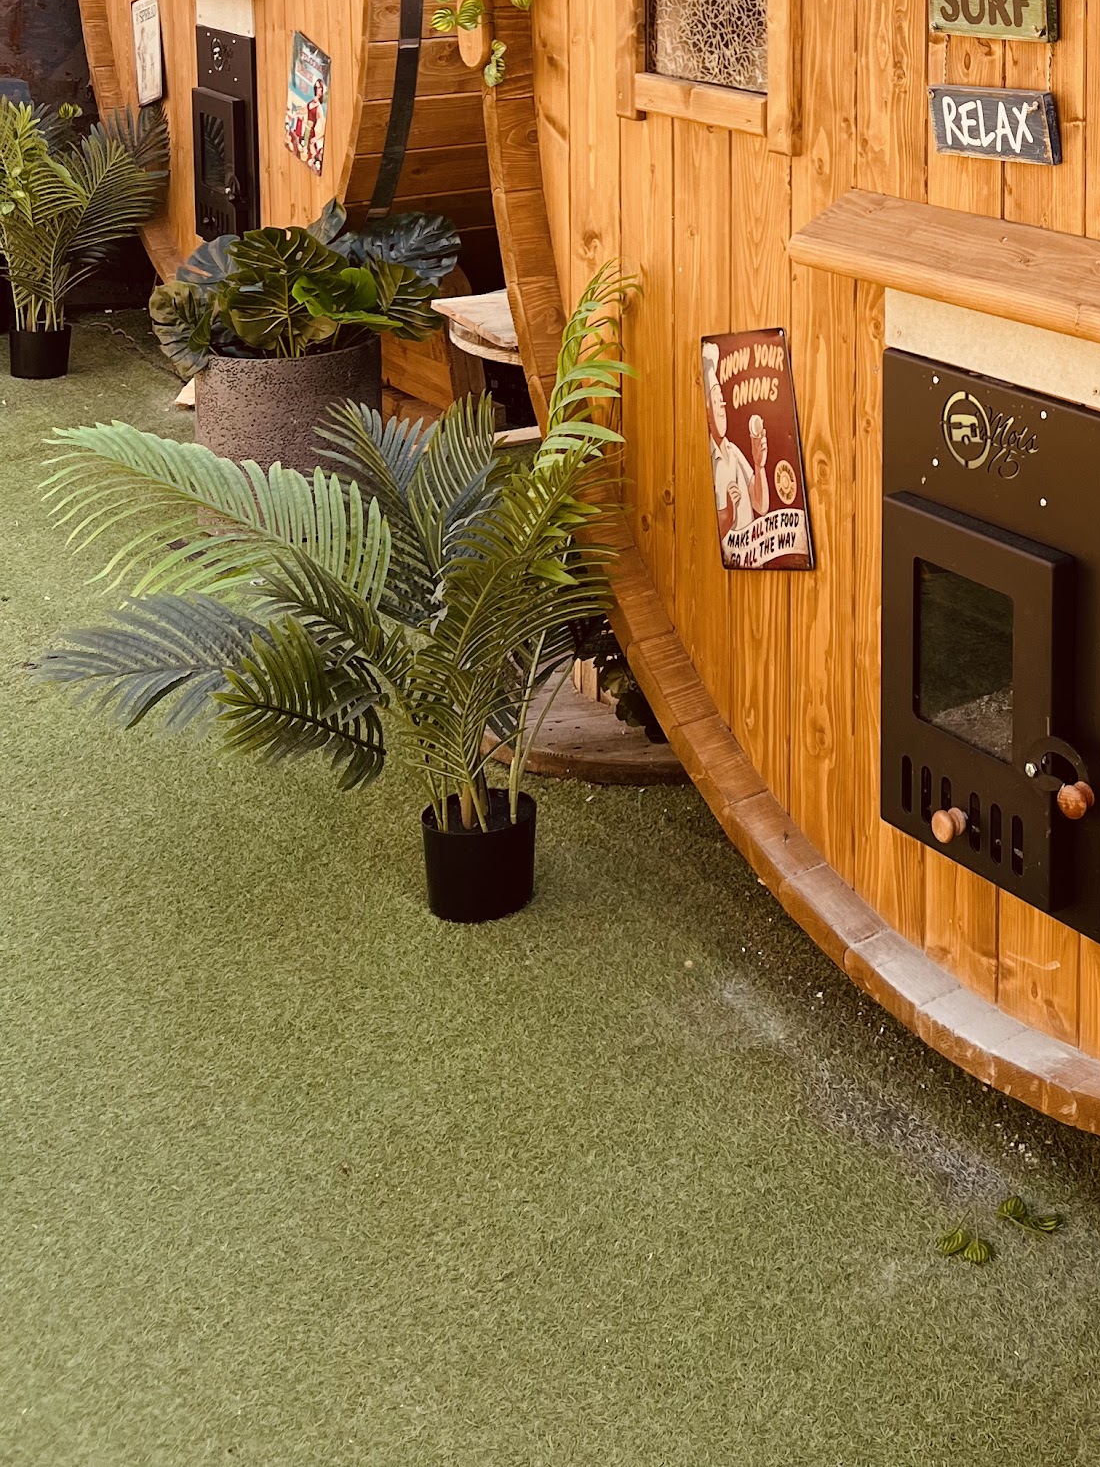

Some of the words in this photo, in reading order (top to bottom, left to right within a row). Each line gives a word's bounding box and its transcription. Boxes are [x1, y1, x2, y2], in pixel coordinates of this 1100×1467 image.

[942, 95, 1034, 153] RELAX
[720, 346, 751, 385] KNOW
[753, 343, 785, 372] YOUR
[732, 376, 779, 410] ONIONS
[727, 529, 750, 548] MAKE
[751, 520, 764, 542] ALL
[764, 514, 779, 533] THE
[780, 512, 799, 528] FOOD
[730, 552, 741, 567] GO
[743, 547, 757, 567] ALL
[759, 536, 775, 558] THE
[777, 532, 796, 550] WAY
